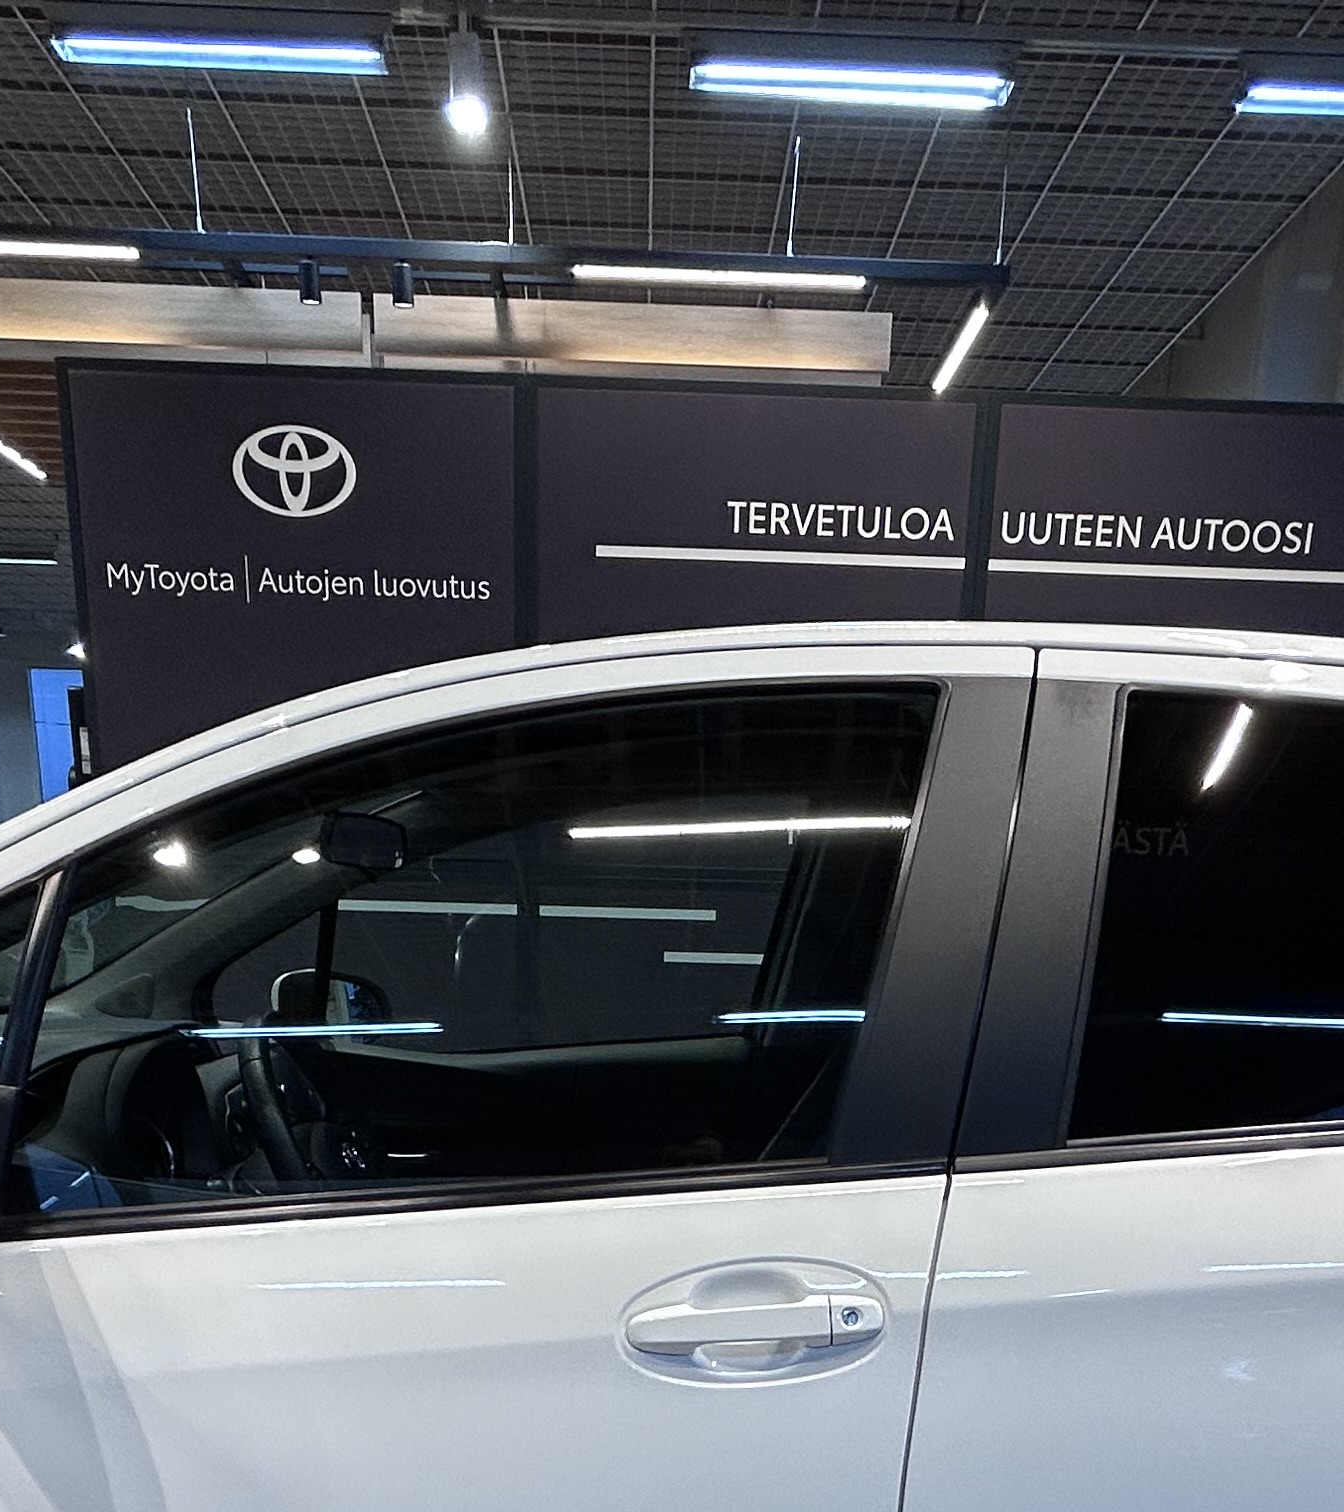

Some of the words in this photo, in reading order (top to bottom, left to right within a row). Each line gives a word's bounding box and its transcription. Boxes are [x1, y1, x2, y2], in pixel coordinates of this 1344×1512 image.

[727, 500, 954, 542] TERVETULOA
[1001, 511, 1143, 550] UUTEEN
[1151, 517, 1314, 555] AUTOOSI
[106, 562, 235, 596] MyToyota
[258, 567, 365, 601] Autojen
[373, 570, 491, 600] luovutus
